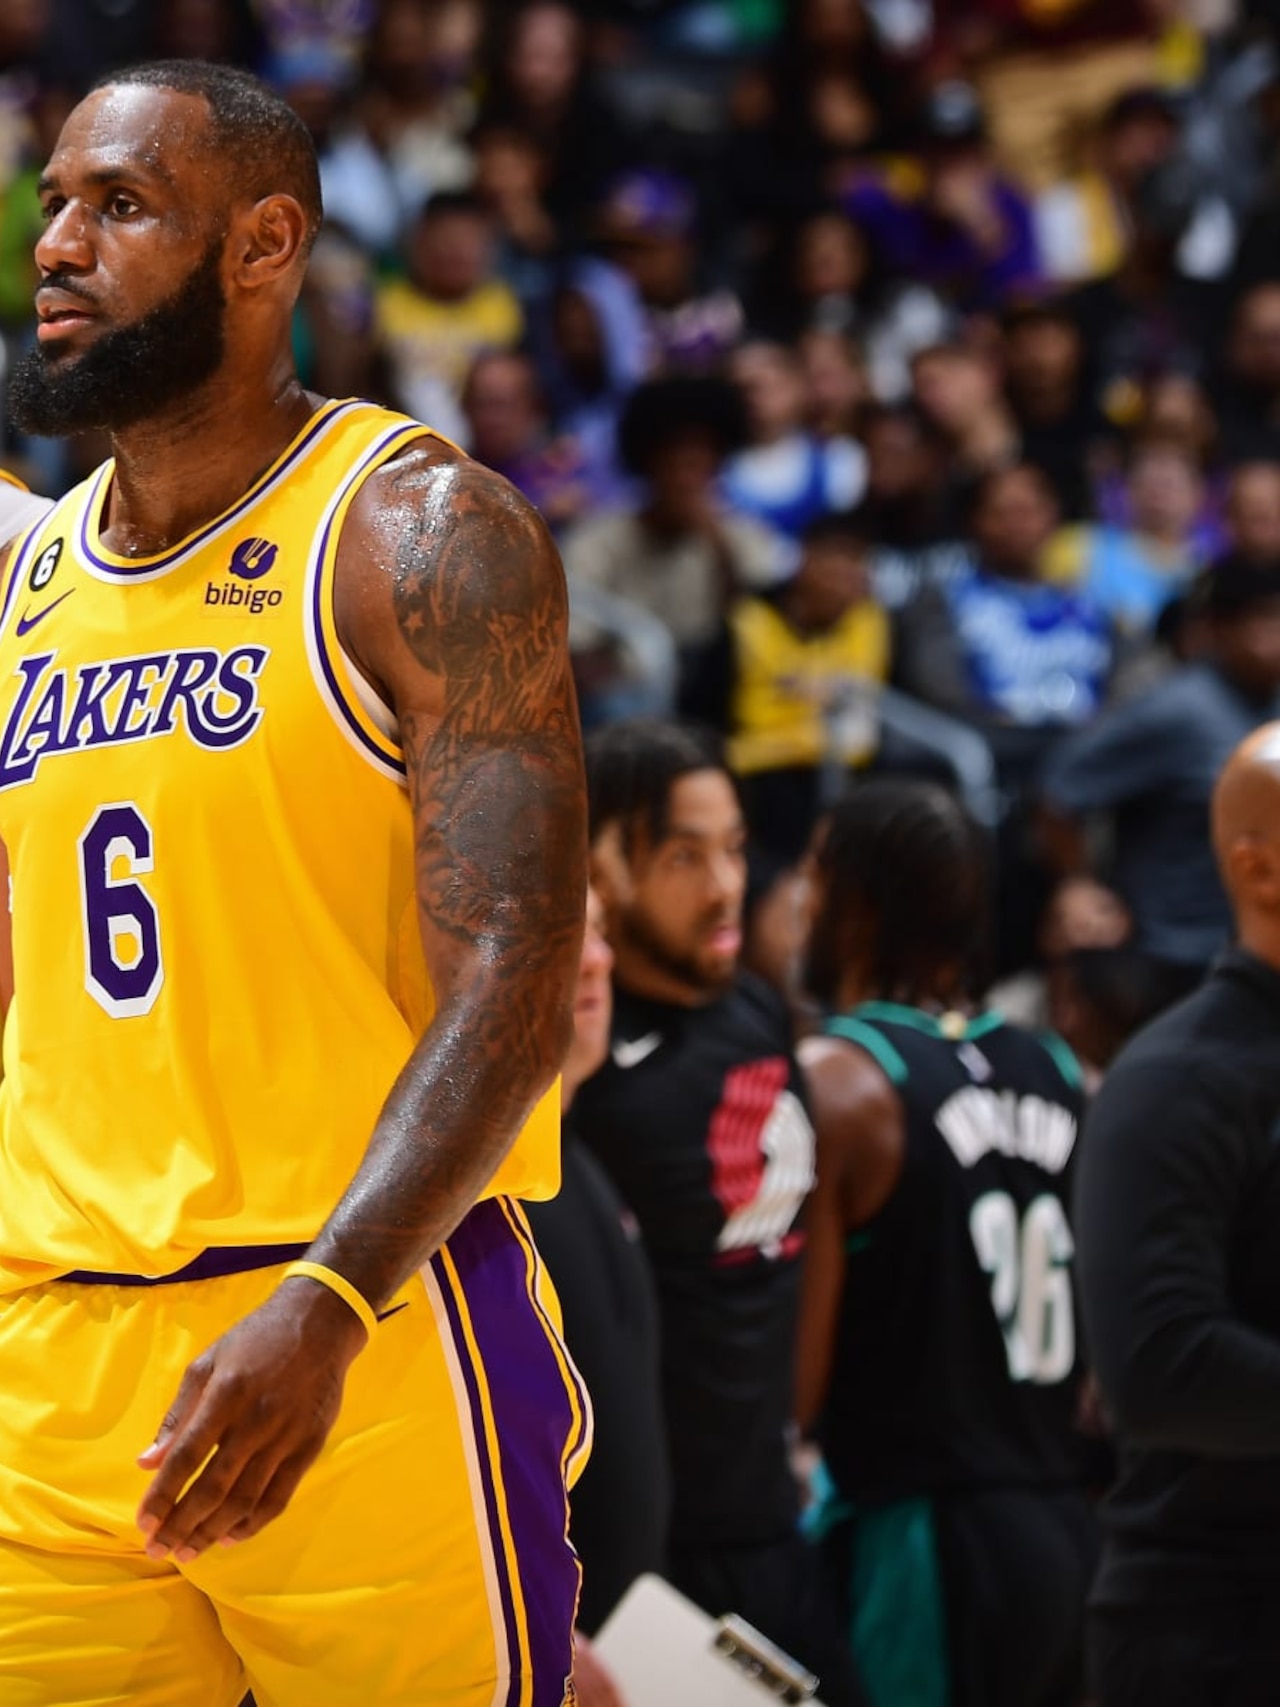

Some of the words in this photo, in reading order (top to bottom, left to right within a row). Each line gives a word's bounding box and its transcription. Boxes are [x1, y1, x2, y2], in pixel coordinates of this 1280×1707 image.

[32, 542, 60, 587] 6
[204, 581, 283, 614] bibigo
[77, 800, 165, 1020] 6
[970, 1191, 1076, 1384] 26
